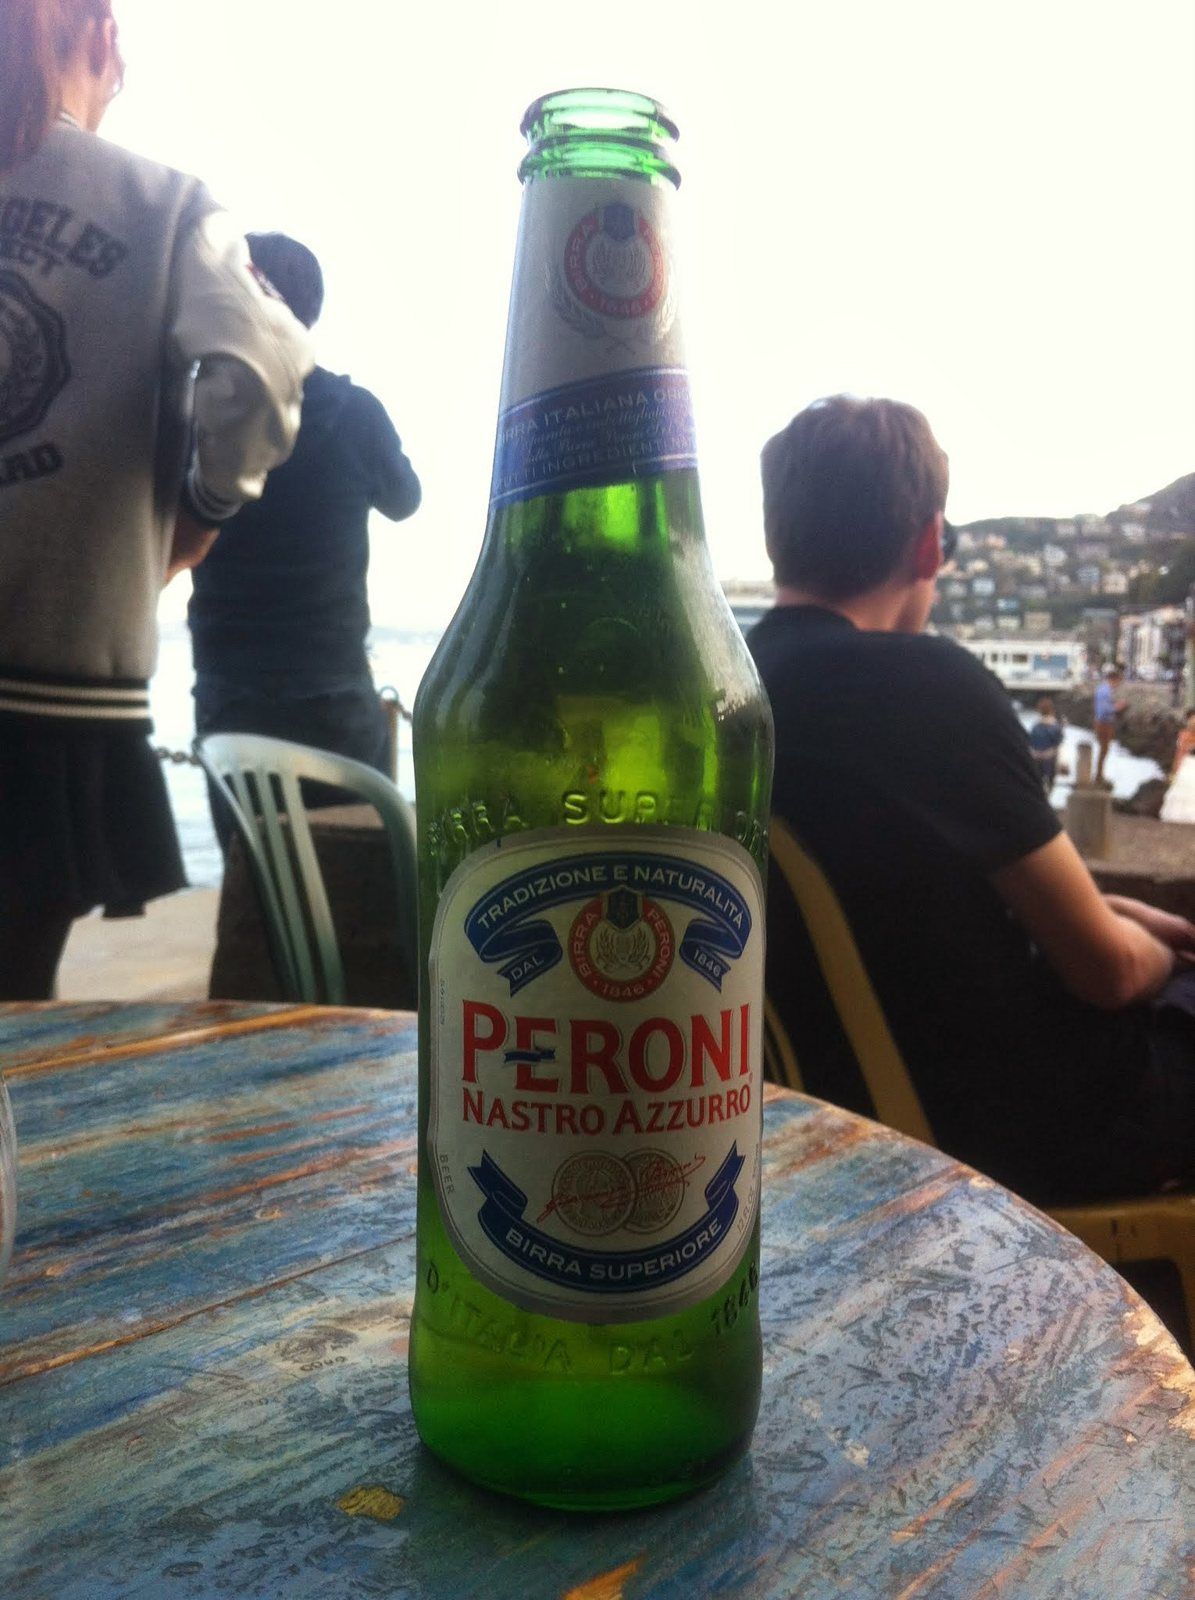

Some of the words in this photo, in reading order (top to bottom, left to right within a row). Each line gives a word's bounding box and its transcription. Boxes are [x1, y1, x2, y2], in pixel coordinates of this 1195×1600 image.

[477, 865, 609, 931] TRADIZIONE
[612, 865, 628, 880] E
[510, 955, 545, 981] DAL
[692, 950, 722, 979] 1846
[646, 907, 671, 980] PERONI
[601, 984, 645, 998] 1846
[461, 999, 750, 1095] PERONI
[462, 1087, 605, 1136] NASTRO
[611, 1083, 751, 1136] AZZURRO
[438, 1152, 456, 1195] BEER
[504, 1226, 583, 1277] BIRRA
[589, 1218, 723, 1282] SUPERIORE
